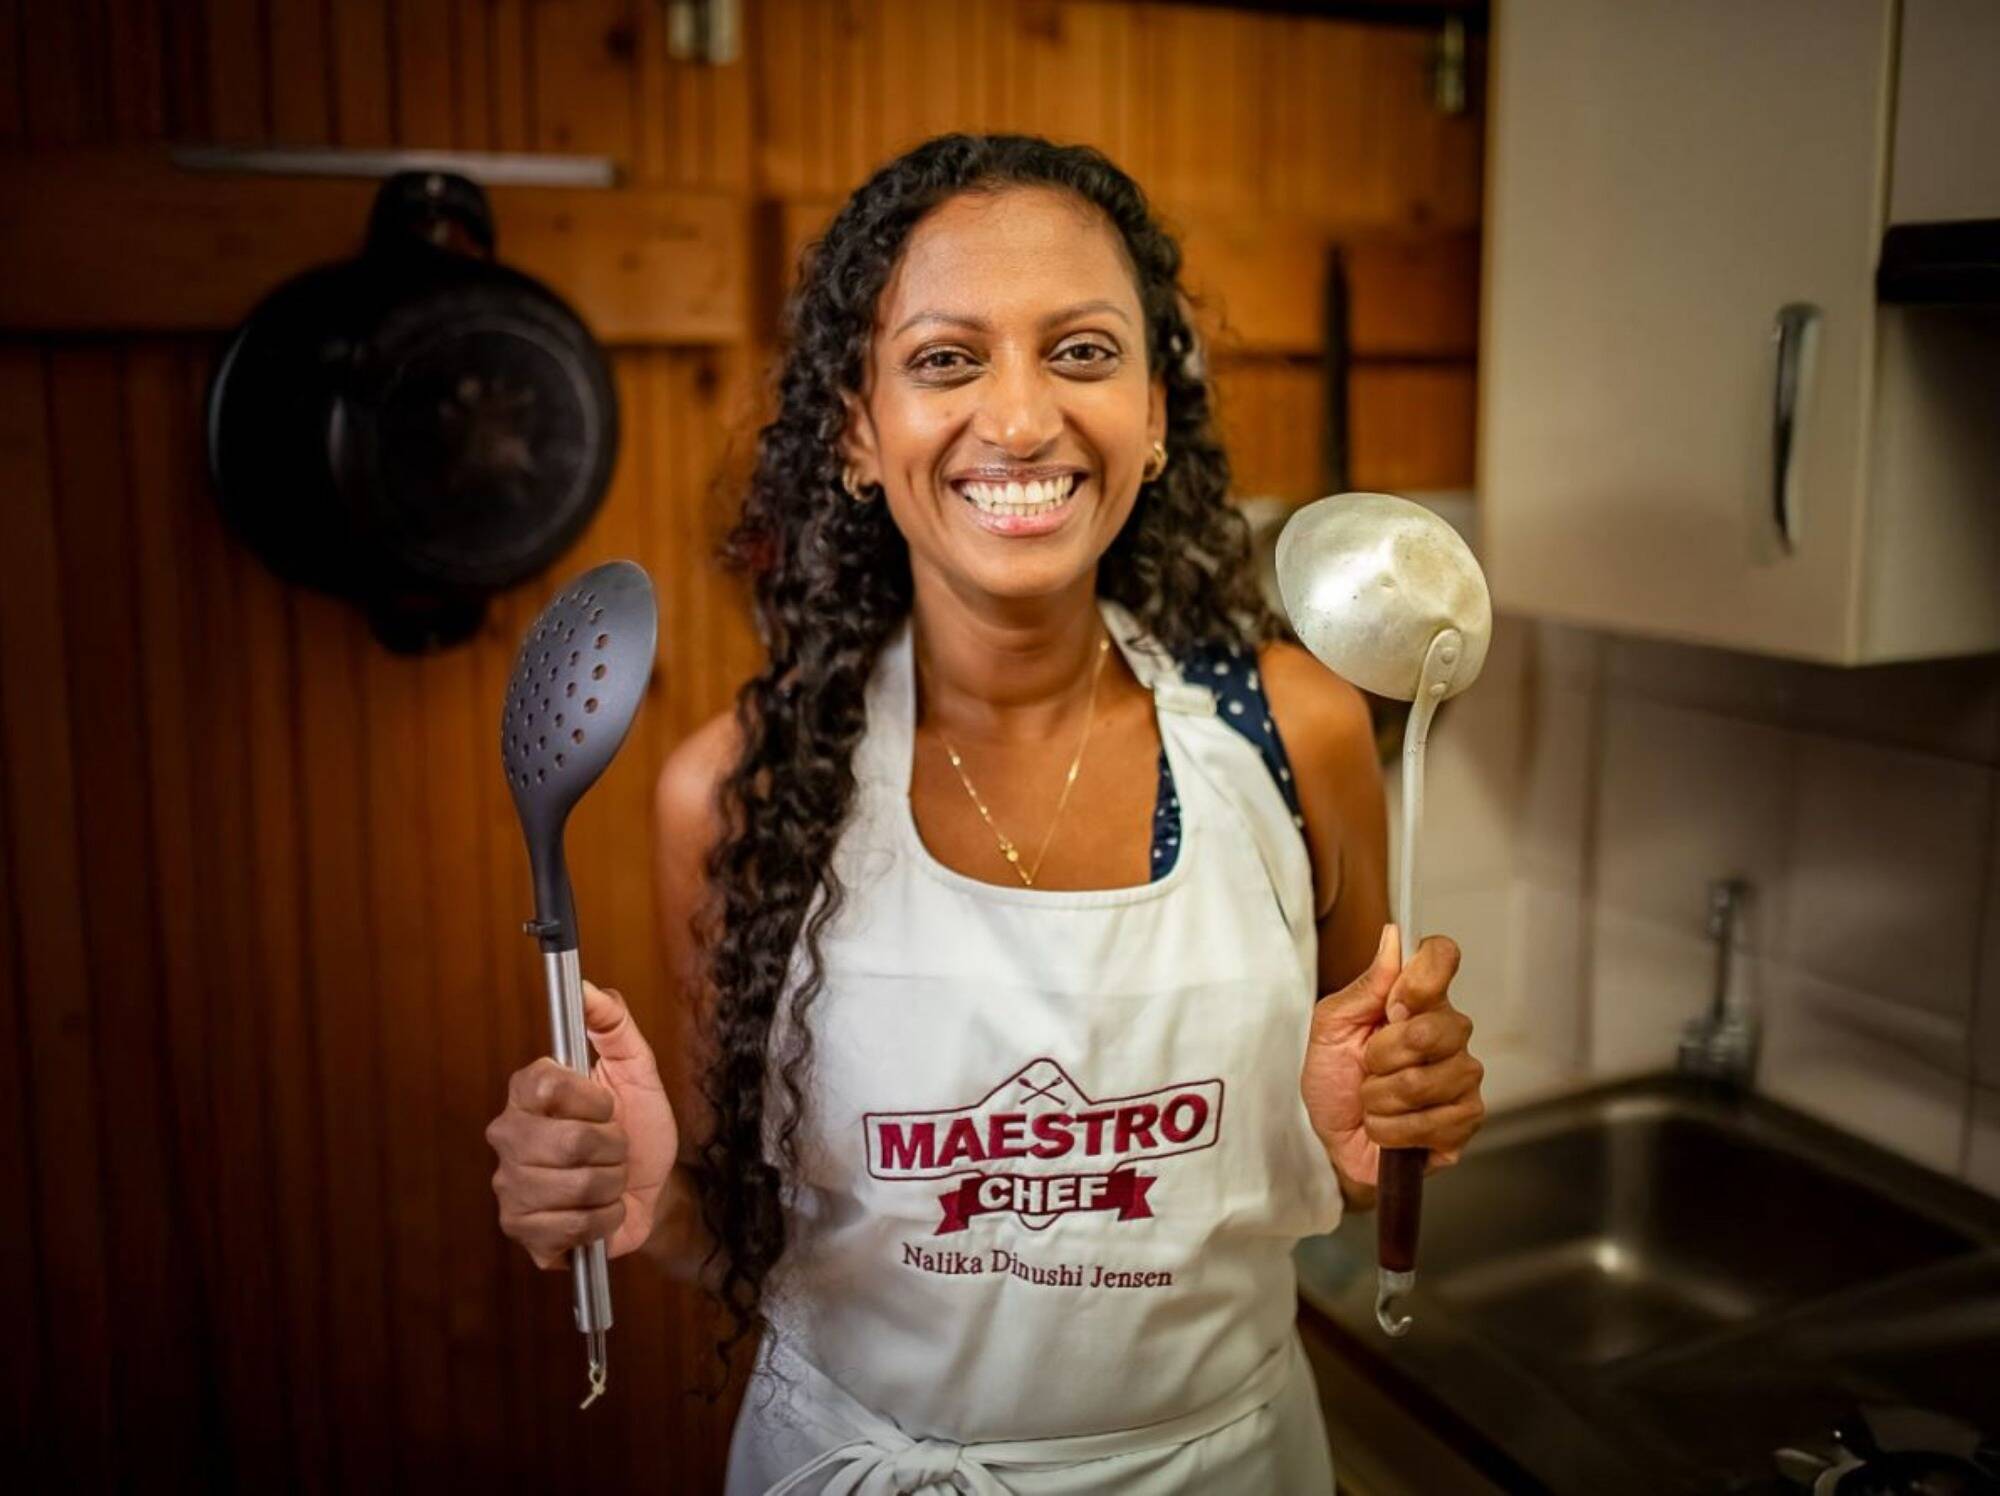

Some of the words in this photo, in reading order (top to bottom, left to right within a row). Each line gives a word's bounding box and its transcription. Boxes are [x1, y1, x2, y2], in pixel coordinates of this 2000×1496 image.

[878, 1093, 1209, 1170] MAESTRO
[977, 1176, 1109, 1213] CHEF
[902, 1243, 983, 1275] Nalika
[991, 1250, 1084, 1287] Dinushi
[1090, 1266, 1173, 1289] Jensen
